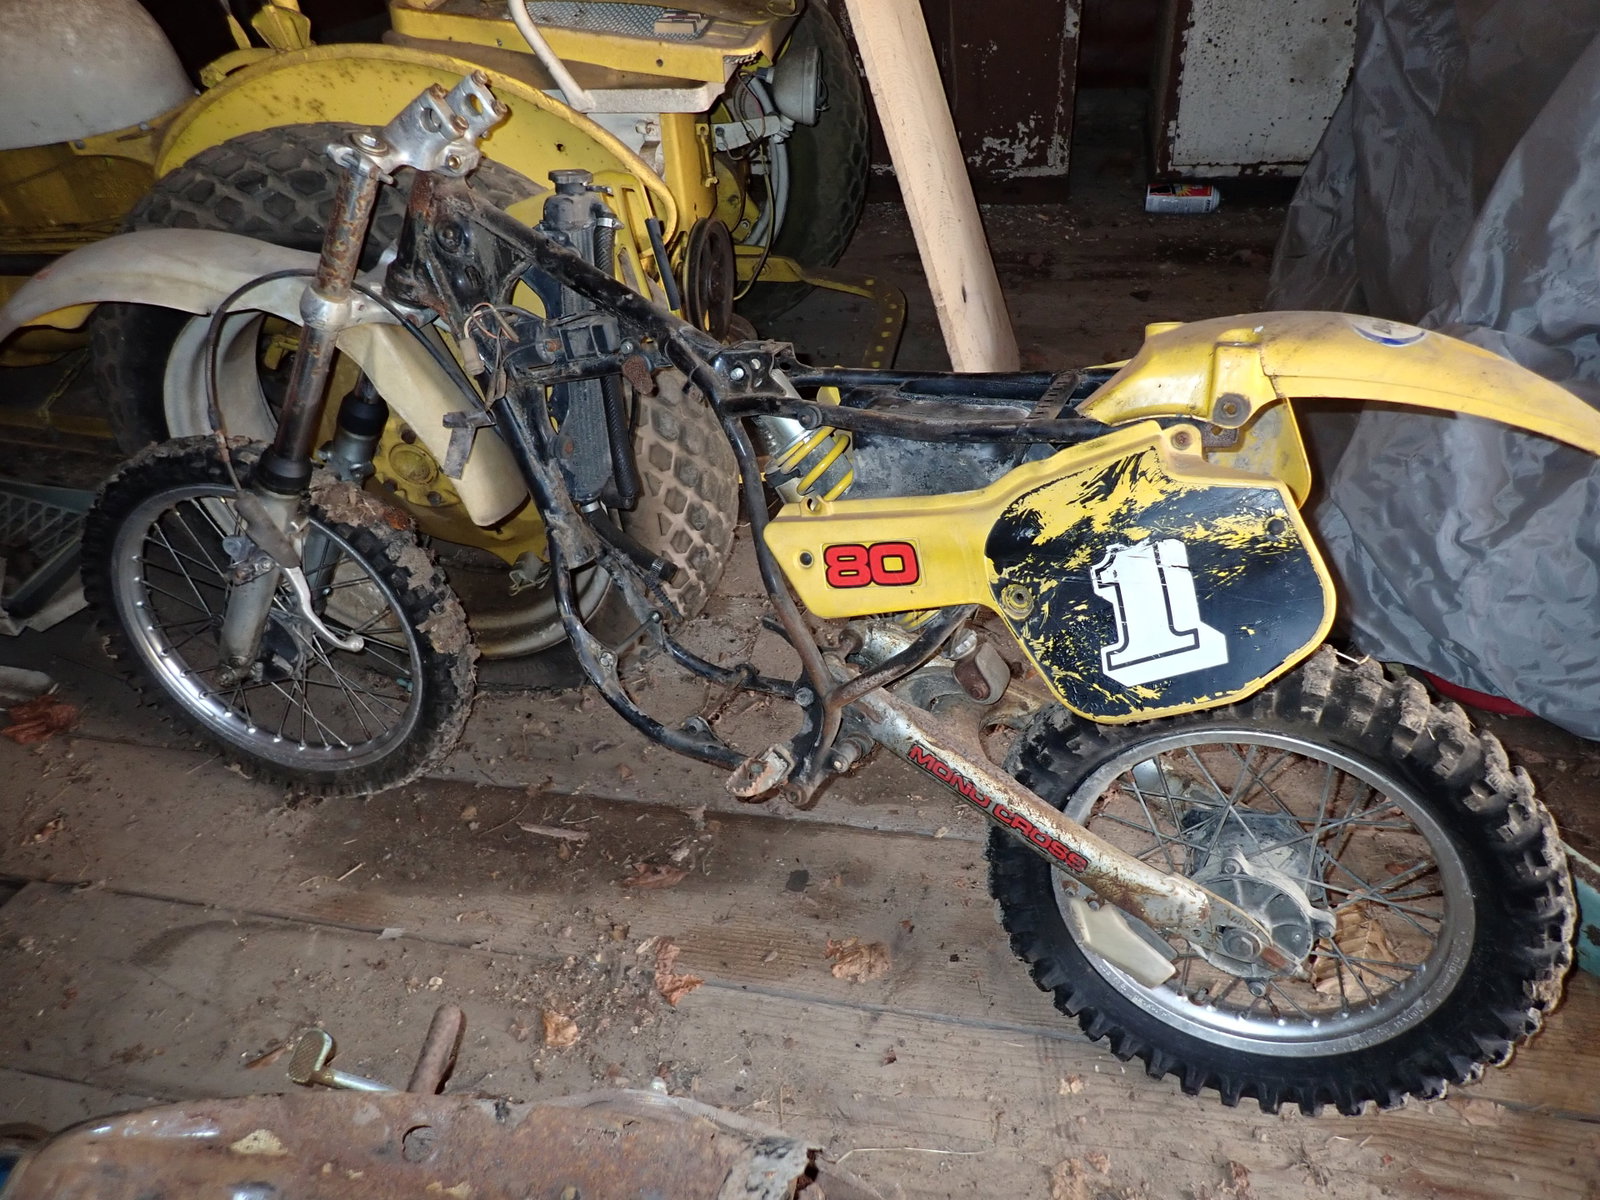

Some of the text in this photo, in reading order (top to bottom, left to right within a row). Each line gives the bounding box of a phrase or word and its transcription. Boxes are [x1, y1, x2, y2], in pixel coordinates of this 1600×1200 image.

[823, 541, 919, 589] 80
[1090, 539, 1229, 687] 1
[907, 745, 1089, 872] MONO CROSS
